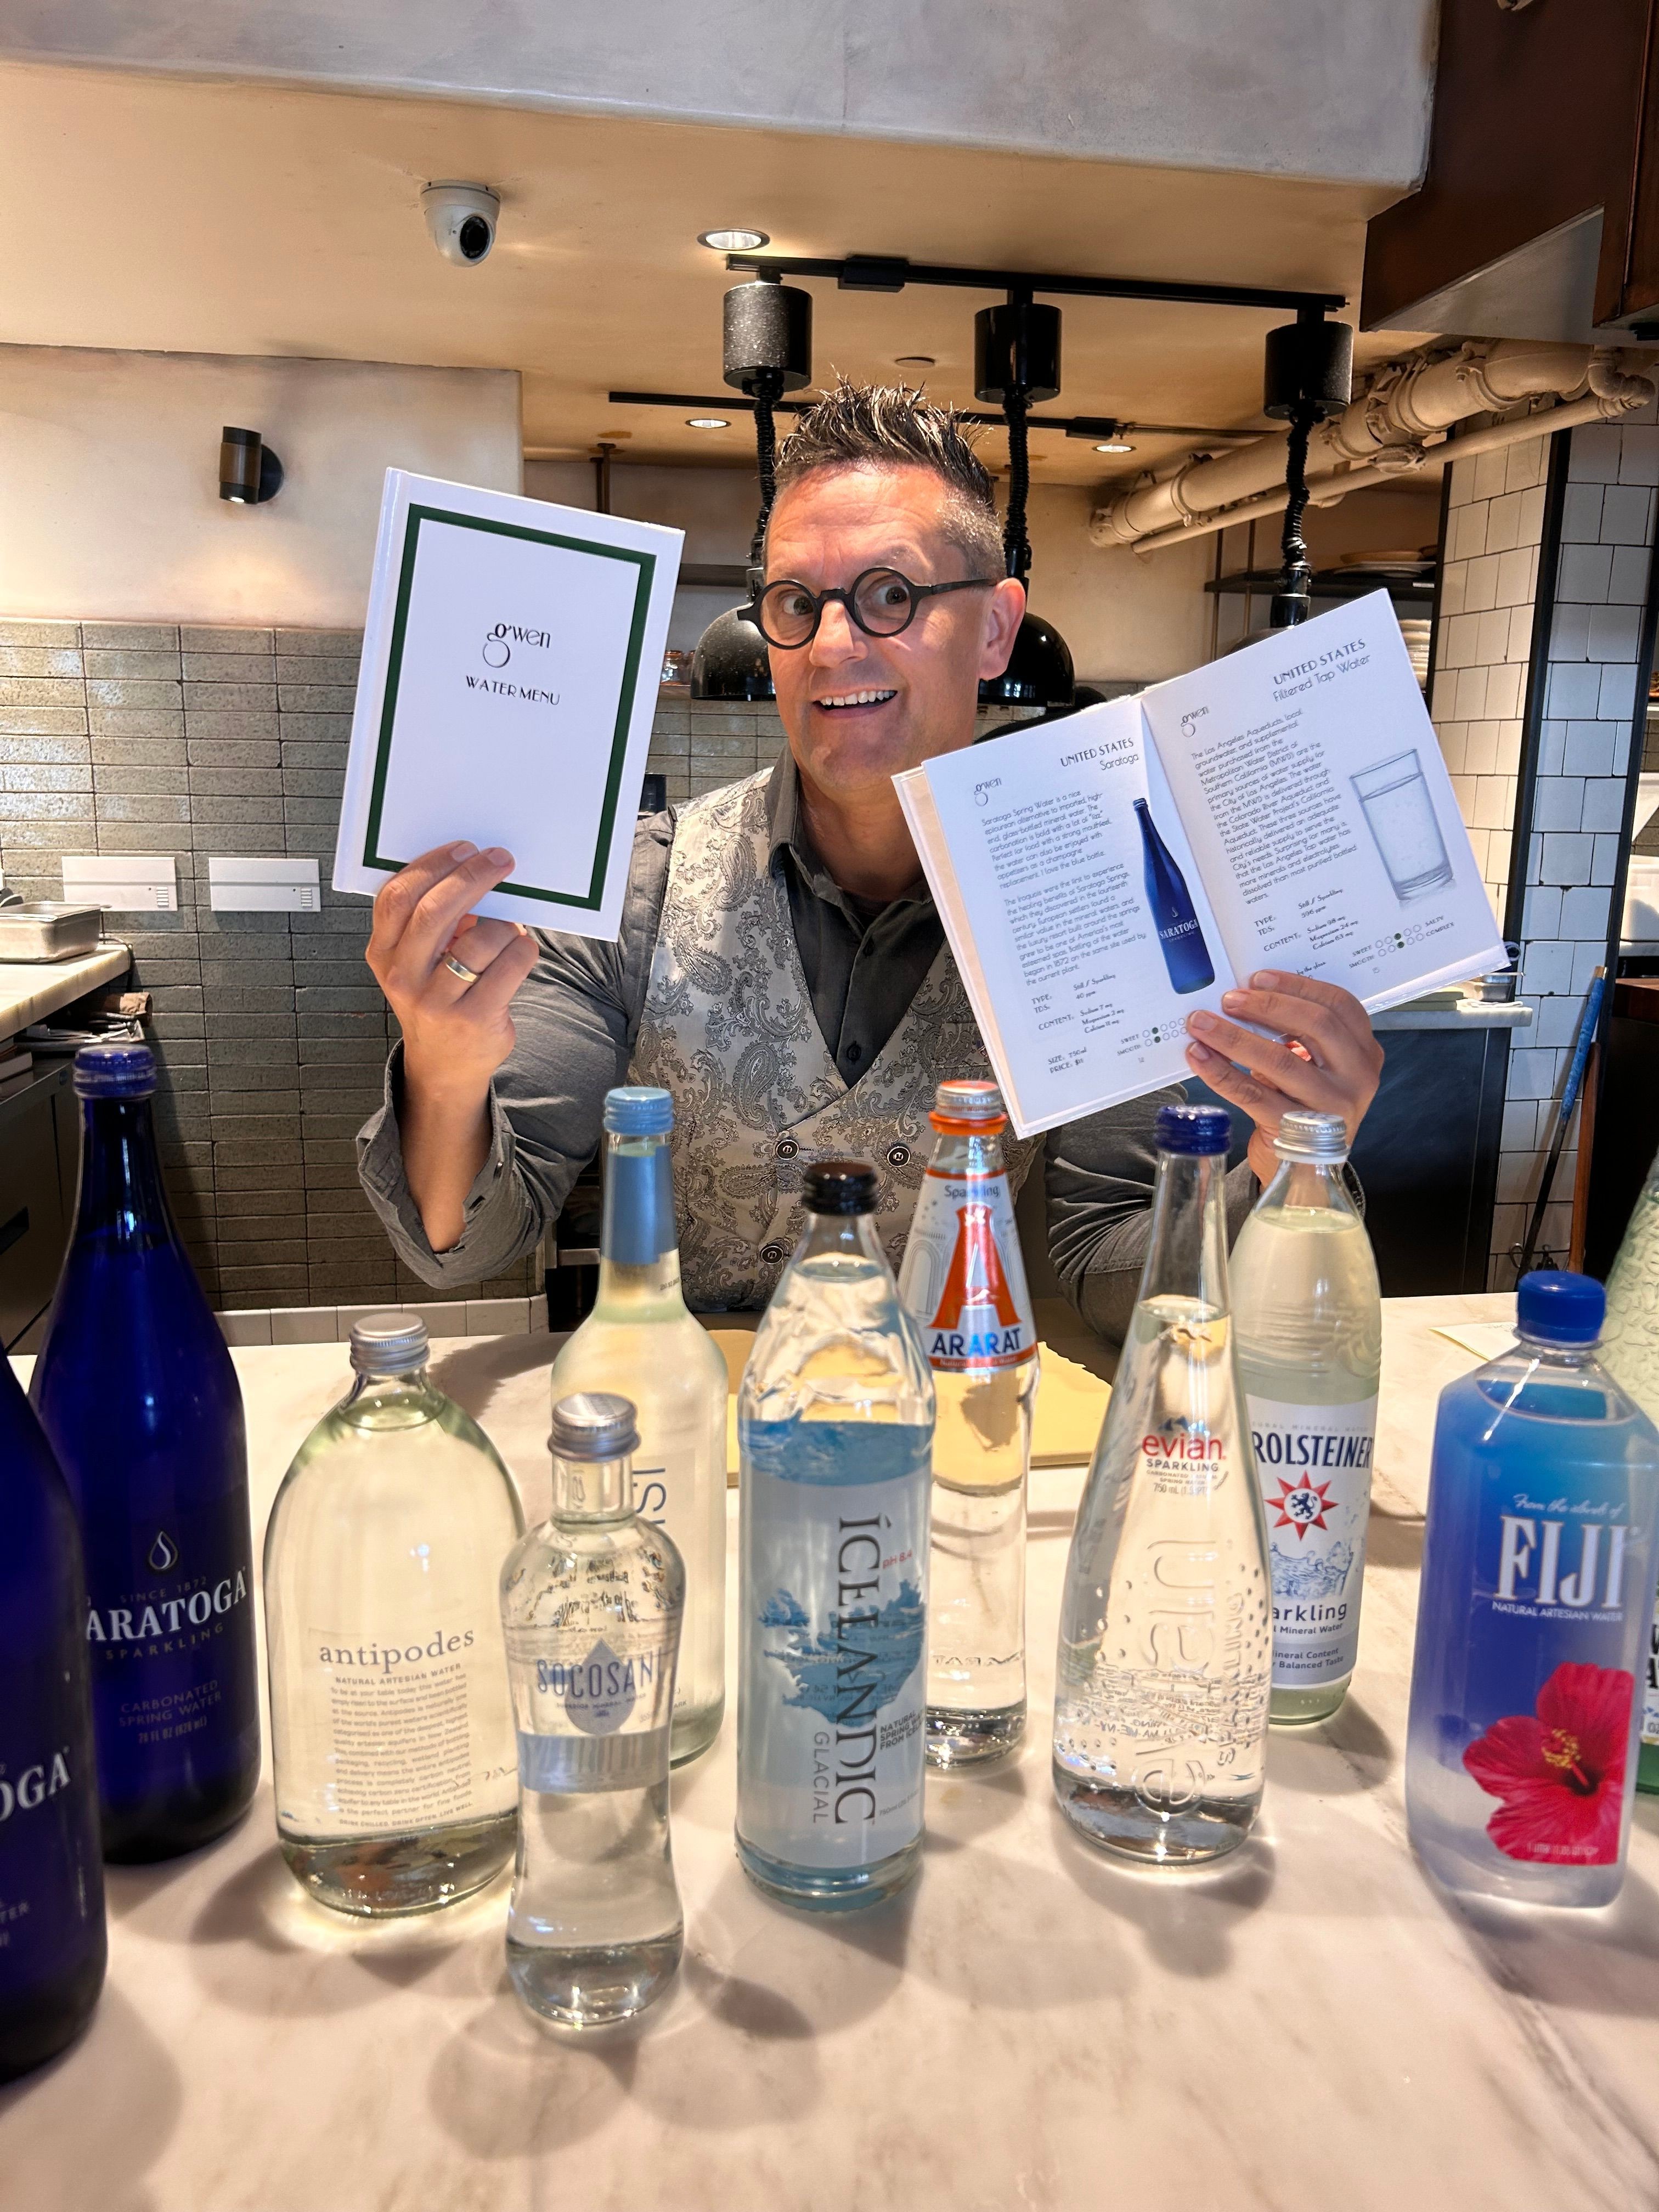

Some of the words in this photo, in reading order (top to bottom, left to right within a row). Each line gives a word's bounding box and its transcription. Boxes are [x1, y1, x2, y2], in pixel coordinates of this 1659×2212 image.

[1272, 659, 1317, 685] UNITED
[1319, 638, 1365, 666] STATES
[466, 675, 517, 698] WATER
[520, 686, 561, 706] MENU
[1272, 676, 1313, 702] Filtered
[1313, 670, 1335, 684] Tap
[1335, 654, 1370, 673] Water
[1190, 751, 1204, 760] The
[1203, 746, 1216, 755] Los
[1216, 733, 1245, 750] Angeles
[1283, 708, 1303, 721] local
[1237, 738, 1253, 751] and
[1253, 719, 1299, 744] supplemental
[1059, 748, 1097, 767] UNITED
[1098, 737, 1134, 755] STATES
[1098, 753, 1139, 771] Saratoga
[1197, 765, 1216, 777] water
[1217, 748, 1254, 771] purchased
[1253, 743, 1271, 754] from
[1271, 738, 1283, 747] the
[1199, 764, 1244, 786] Metropolitan
[1243, 754, 1266, 767] Water
[1266, 744, 1289, 759] District
[1289, 740, 1298, 749] of
[1203, 778, 1233, 794] Southern
[1233, 764, 1268, 782] California
[1295, 747, 1308, 756] are
[1308, 742, 1321, 751] the
[1206, 788, 1234, 805] primary
[1234, 777, 1261, 792] sources
[1260, 772, 1268, 781] of
[1269, 765, 1289, 777] water
[1290, 755, 1314, 769] supply
[1314, 750, 1325, 758] for
[1209, 803, 1222, 812] the
[1221, 797, 1237, 806] City
[1237, 792, 1245, 801] of
[1244, 788, 1258, 797] Los
[1287, 770, 1302, 779] The
[1302, 761, 1322, 773] water
[980, 812, 1012, 826] Saratoga
[1012, 805, 1034, 817] Spring
[1033, 798, 1054, 809] Water
[1067, 790, 1081, 798] nice
[984, 820, 1016, 835] epicurean
[1016, 809, 1051, 825] alternative
[1042, 812, 1067, 826] mineral
[1085, 803, 1098, 811] The
[1160, 918, 1199, 939] SARATOGA
[931, 1327, 1020, 1357] ARARAT
[1142, 1432, 1223, 1460] evian
[1251, 1430, 1373, 1468] ROLSTEINER
[1146, 1458, 1219, 1472] SPARKLING
[1493, 1515, 1628, 1607] FIJI
[86, 1570, 247, 1641] ARATOGA
[1273, 1602, 1347, 1621] arkling
[1492, 1600, 1538, 1617] NATURAL
[1538, 1607, 1590, 1621] ARTESIAN
[105, 1622, 225, 1660] SPARKLING
[1280, 1625, 1317, 1635] Mineral
[1319, 1623, 1344, 1633] Water
[320, 1628, 475, 1674] antipodes
[1279, 1660, 1323, 1669] Balanced
[1325, 1656, 1344, 1667] Taste
[1306, 1647, 1339, 1659] Content
[335, 1676, 376, 1686] NATURAL
[379, 1671, 428, 1685] ARTESIAN
[431, 1662, 462, 1678] WATER
[880, 1709, 917, 1733] NATURAL
[880, 1723, 910, 1742] SPRING
[879, 1736, 905, 1750] FROM
[812, 1731, 830, 1824] GLACIAL
